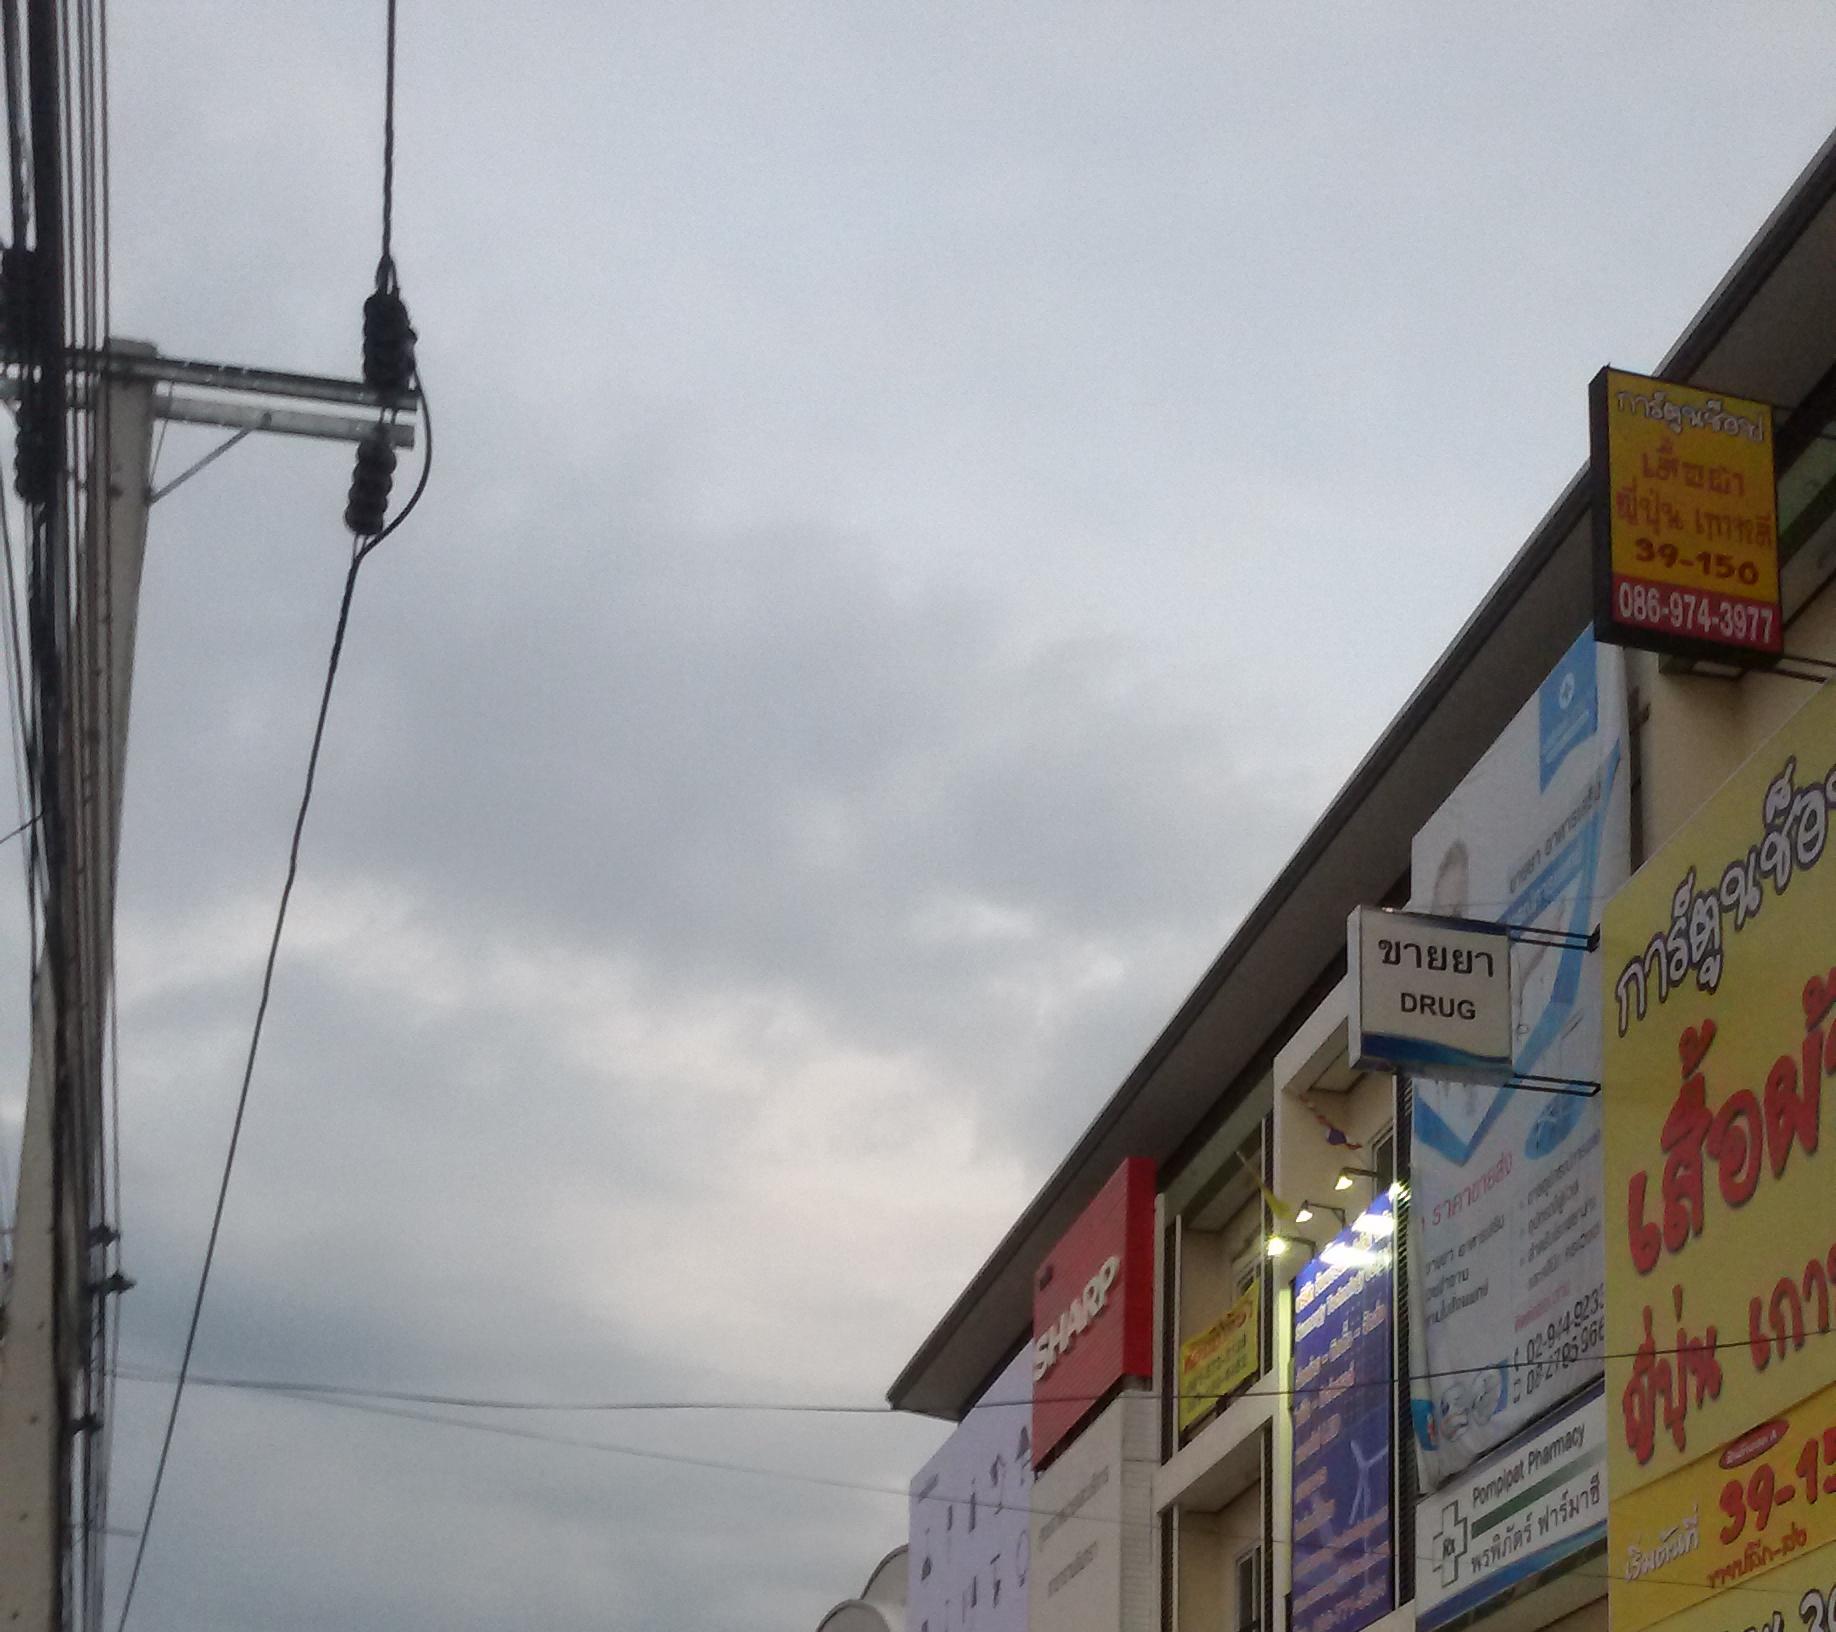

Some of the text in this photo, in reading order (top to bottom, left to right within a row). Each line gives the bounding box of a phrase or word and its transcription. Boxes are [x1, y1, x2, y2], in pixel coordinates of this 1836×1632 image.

[1634, 537, 1759, 586] 39-150
[1618, 582, 1774, 644] 086-974-3977
[1615, 755, 1836, 1037] การ์ตูนช็อ
[1378, 939, 1494, 978] ขายยา
[1400, 992, 1476, 1020] DRUG
[1032, 1256, 1120, 1382] SHARP
[1749, 1243, 1836, 1372] เกา
[1528, 1424, 1585, 1472] Pharmacy
